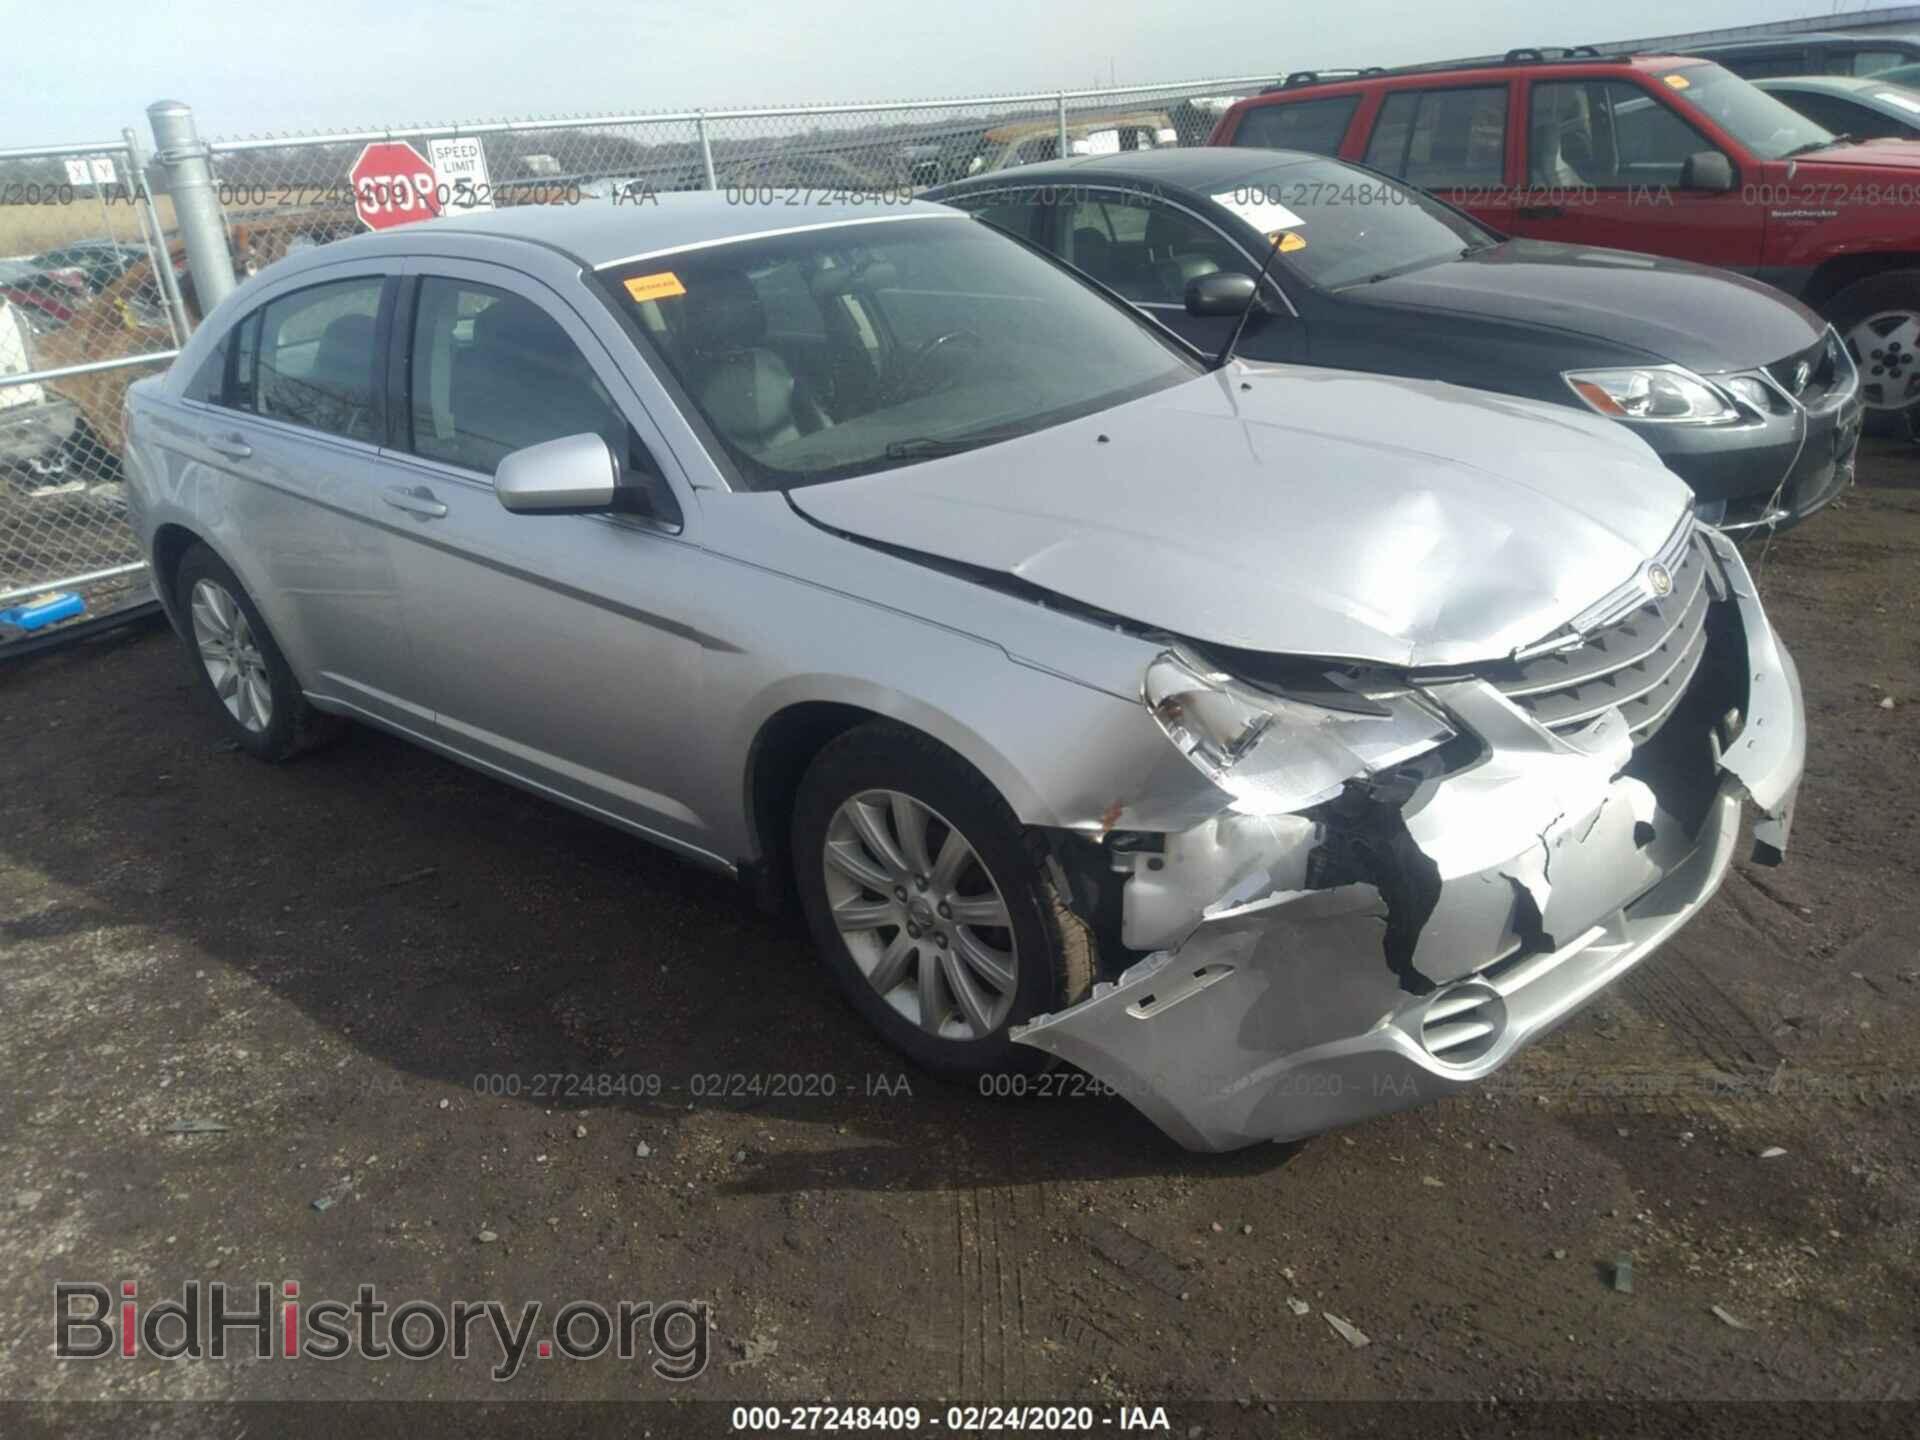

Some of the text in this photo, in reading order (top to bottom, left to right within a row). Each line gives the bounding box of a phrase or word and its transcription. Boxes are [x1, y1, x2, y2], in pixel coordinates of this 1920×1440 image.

[436, 145, 478, 160] SPEED
[443, 159, 477, 174] LIMIT
[358, 172, 433, 215] STOP
